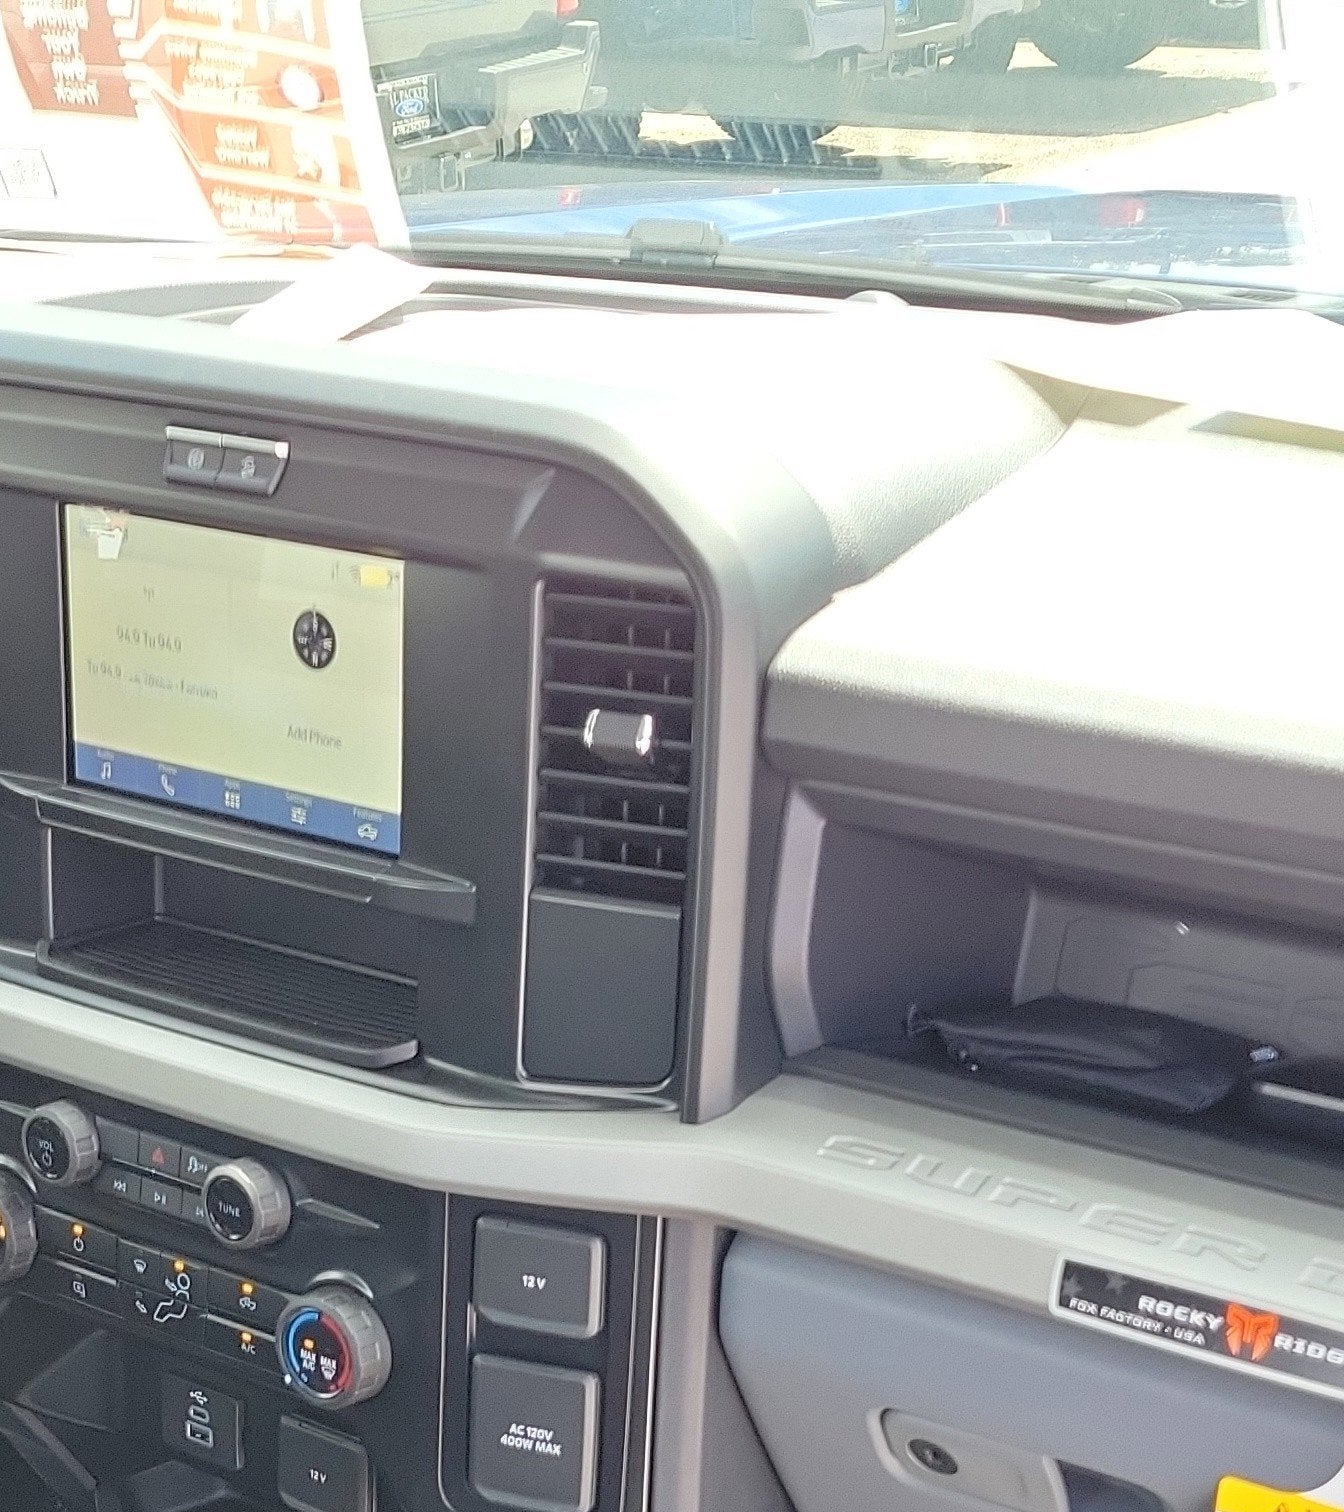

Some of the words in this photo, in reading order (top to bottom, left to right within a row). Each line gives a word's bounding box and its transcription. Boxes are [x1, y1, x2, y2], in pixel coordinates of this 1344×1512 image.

[287, 726, 308, 742] Add
[309, 728, 343, 749] Phone
[38, 1140, 54, 1153] VOL
[218, 1201, 241, 1218] TUNE
[816, 1134, 1267, 1272] SUPER
[1069, 1297, 1098, 1316] FOX
[1099, 1306, 1164, 1334] FACTORY
[1173, 1327, 1205, 1346] USA
[1137, 1294, 1224, 1331] ROCKY
[300, 1348, 316, 1361] MAX
[509, 1423, 525, 1437] AC
[527, 1426, 554, 1442] 120V
[500, 1434, 533, 1450] 400W
[535, 1441, 562, 1457] MAX
